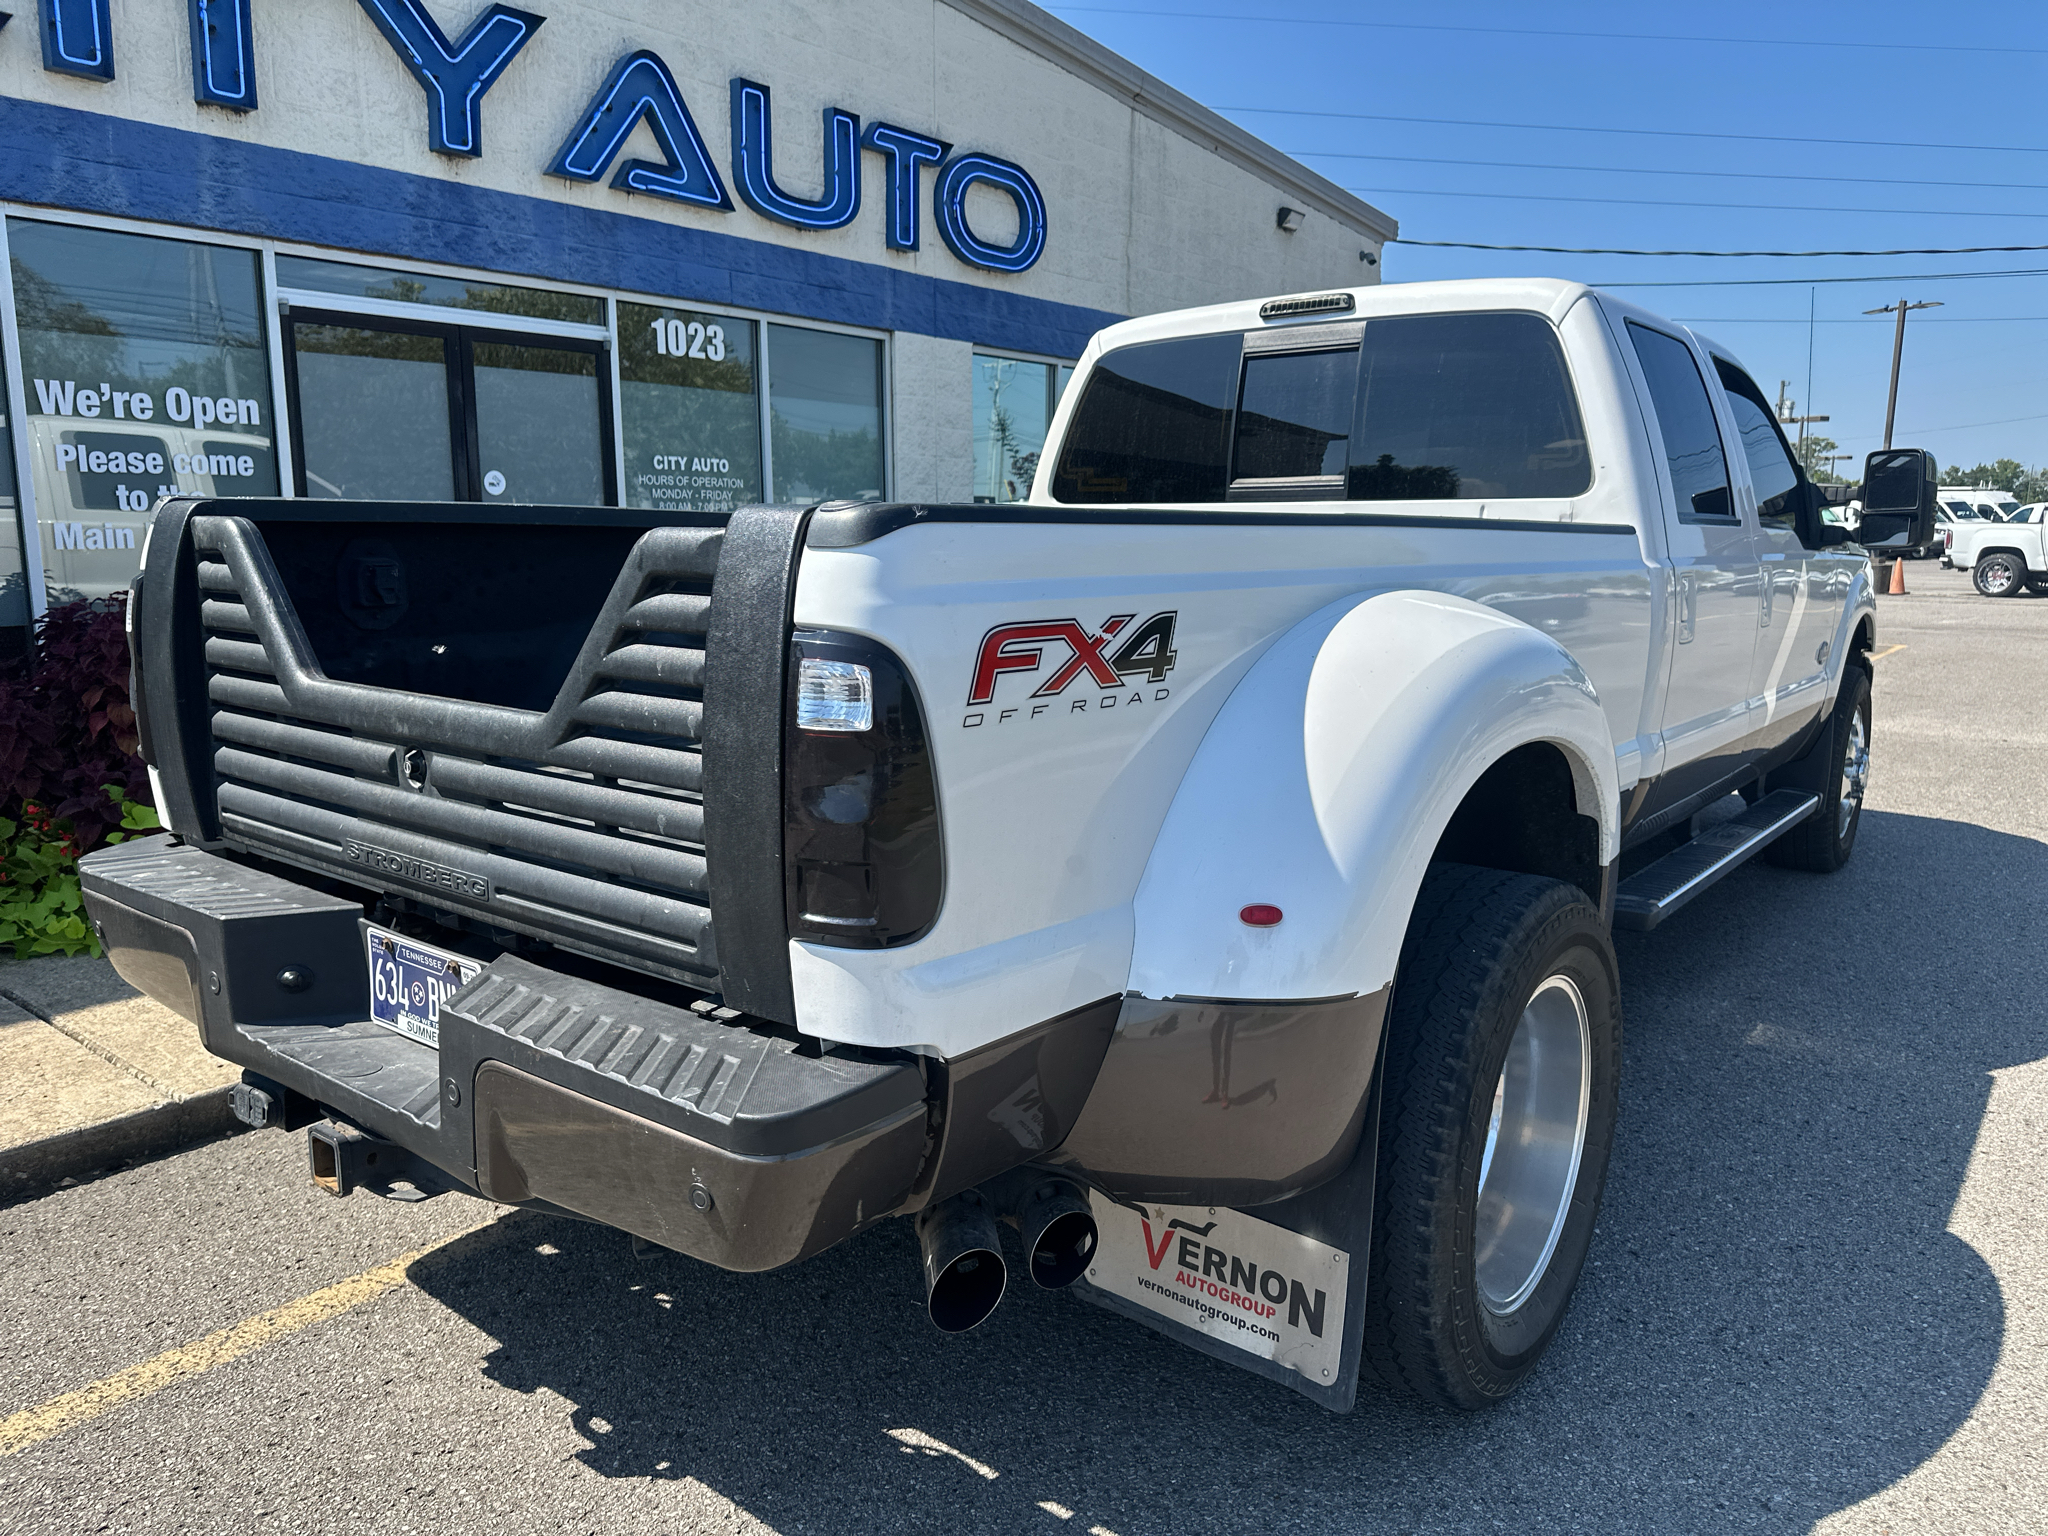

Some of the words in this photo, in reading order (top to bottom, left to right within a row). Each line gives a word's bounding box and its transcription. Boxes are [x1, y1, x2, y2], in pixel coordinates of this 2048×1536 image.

[544, 49, 1047, 274] AUTO
[651, 318, 725, 362] 1023
[33, 379, 154, 420] We're
[165, 386, 260, 430] Open
[54, 444, 164, 474] Please
[173, 453, 255, 477] come
[653, 454, 688, 472] CITY
[692, 457, 729, 474] AUTO
[115, 484, 149, 512] to
[638, 474, 674, 486] HOURS
[676, 475, 689, 487] OF
[691, 476, 744, 488] OPERATION
[652, 488, 693, 499] MONDAY
[700, 489, 734, 501] FRIDAY
[658, 501, 676, 510] 8:00
[678, 502, 691, 510] AM
[53, 522, 135, 551] Main
[966, 610, 1178, 706] FX4
[963, 704, 1050, 728] OFF
[1070, 688, 1170, 714] ROAD
[347, 842, 486, 897] STROMBERG
[401, 948, 443, 970] TENNESSEE
[375, 958, 409, 1011] 634
[407, 1012, 421, 1021] GOD
[421, 1017, 432, 1027] WE
[407, 1020, 437, 1042] SUMNE
[1141, 1217, 1326, 1339] VERNON
[1175, 1270, 1276, 1320] AUTOGROUP
[1137, 1276, 1280, 1342] vernonautogroup.com
